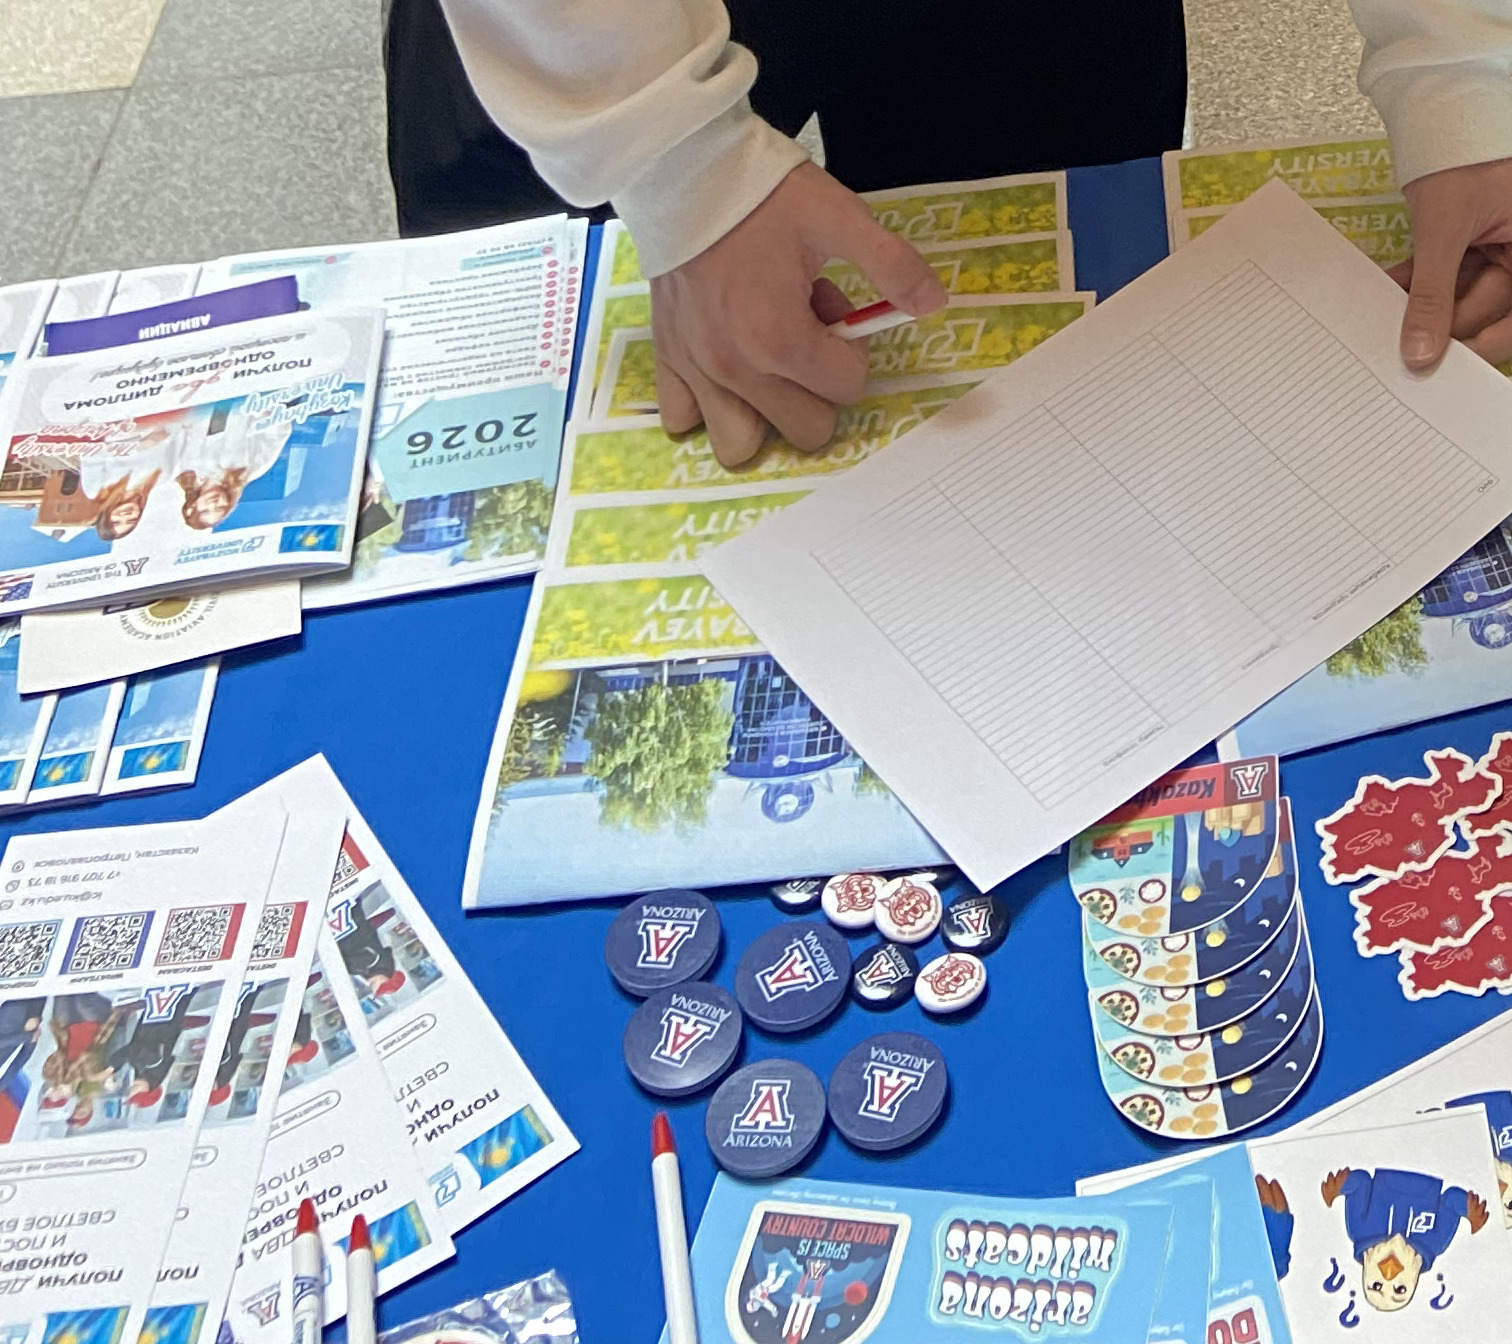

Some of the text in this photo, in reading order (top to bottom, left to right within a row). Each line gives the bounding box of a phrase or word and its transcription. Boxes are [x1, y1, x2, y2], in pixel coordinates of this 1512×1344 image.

[138, 313, 211, 340] АВИАЦИИ
[115, 349, 275, 390] ОДНОВРЕМЕННО
[232, 357, 312, 381] ПОЛУЧИ
[63, 384, 164, 412] ДИПЛОМА
[406, 412, 539, 456] 2026
[408, 438, 538, 469] АБИТУРИЕНТ
[641, 905, 707, 922] ARIZONA
[802, 929, 839, 983] ARIZONA
[671, 993, 732, 1023] ARIZONA
[869, 1045, 935, 1073] ARIZONA
[423, 1088, 500, 1143] ПОЛУЧИ
[722, 1133, 793, 1148] ARIZONA
[254, 1143, 345, 1198] СВЕТЛОЕ
[318, 1180, 388, 1225] ПОЛУЧ
[22, 1209, 117, 1232] СВЕТЛОЕ
[761, 1213, 891, 1247] WILDCAT COUNTRY
[796, 1238, 851, 1261] SPACE IS
[945, 1218, 1118, 1280] wildcats
[36, 1267, 125, 1290] ПОЛУЧИ
[938, 1271, 1096, 1334] arizona
